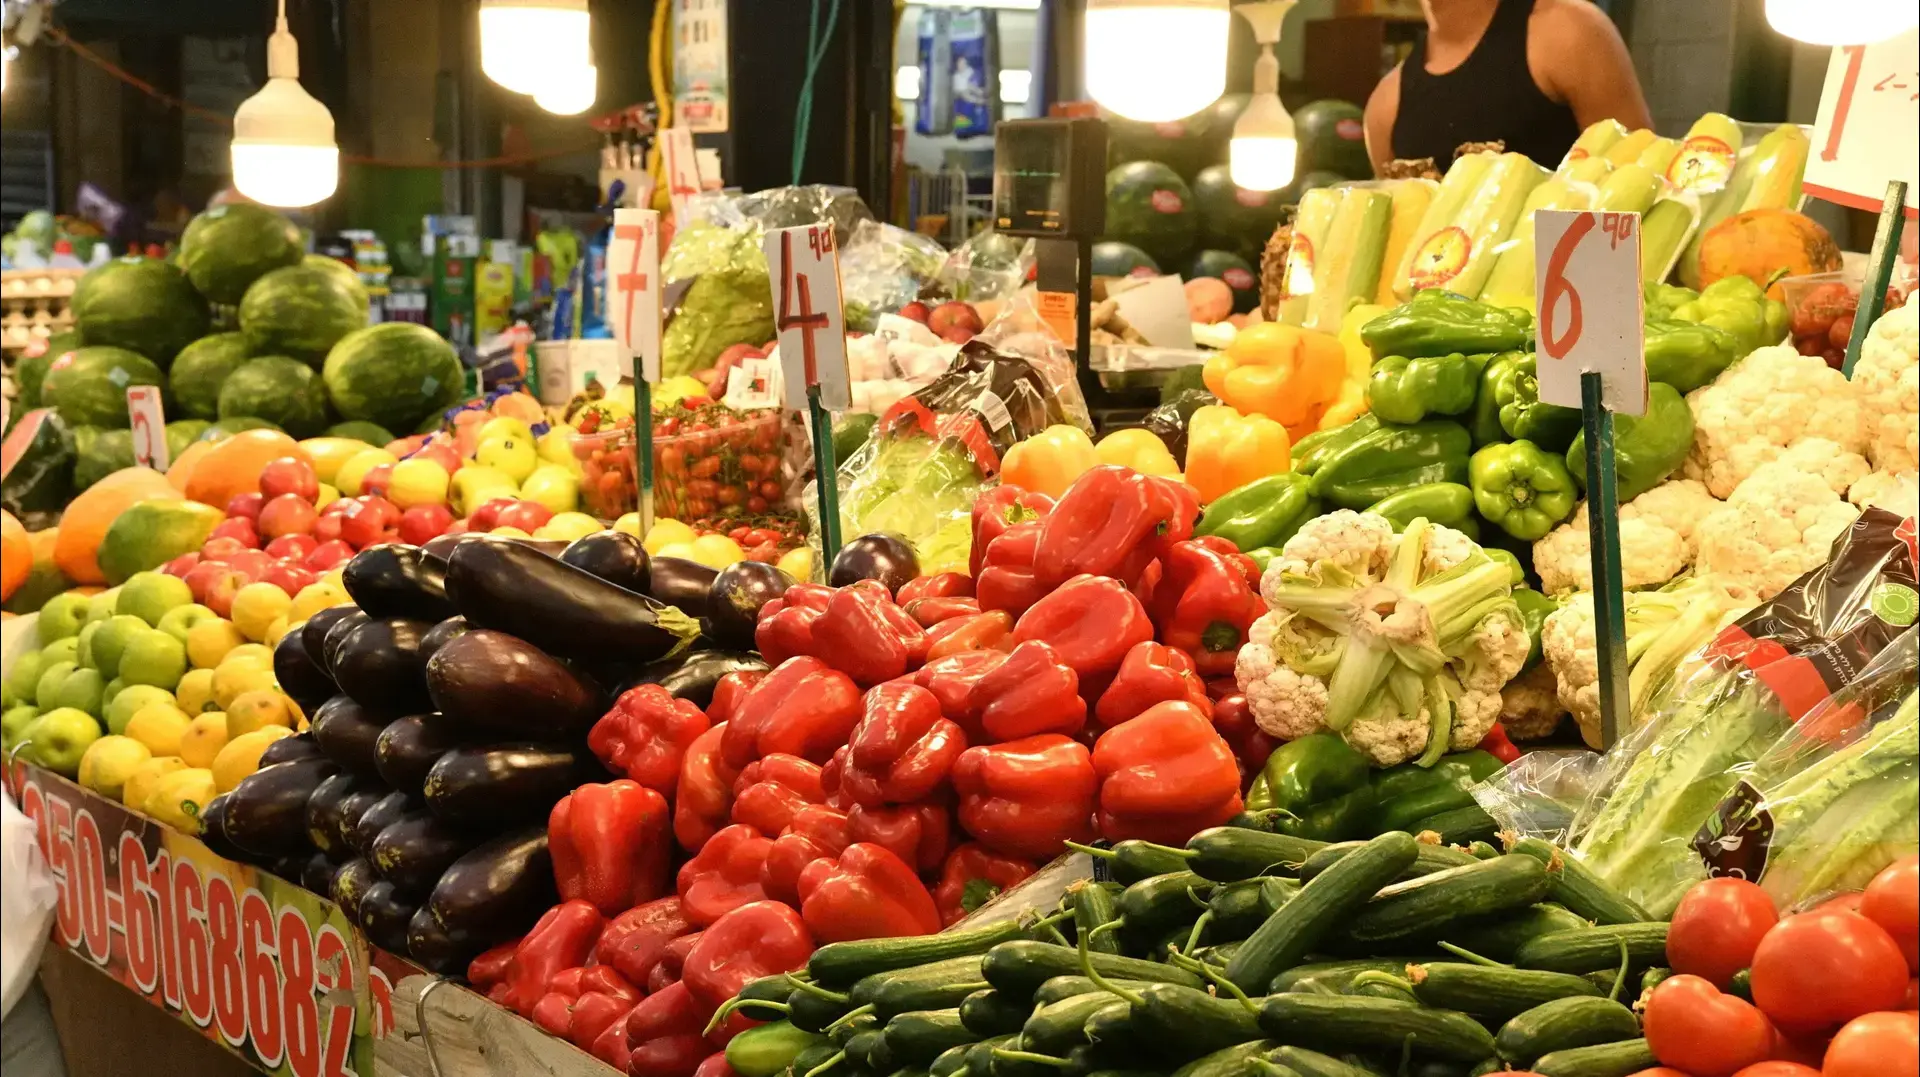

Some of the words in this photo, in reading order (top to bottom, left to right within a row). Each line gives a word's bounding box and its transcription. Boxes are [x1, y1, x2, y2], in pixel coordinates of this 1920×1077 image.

[615, 225, 647, 349] 7
[778, 230, 829, 386] 4
[808, 226, 833, 261] 90
[1541, 212, 1596, 360] 6
[1603, 213, 1634, 251] 90
